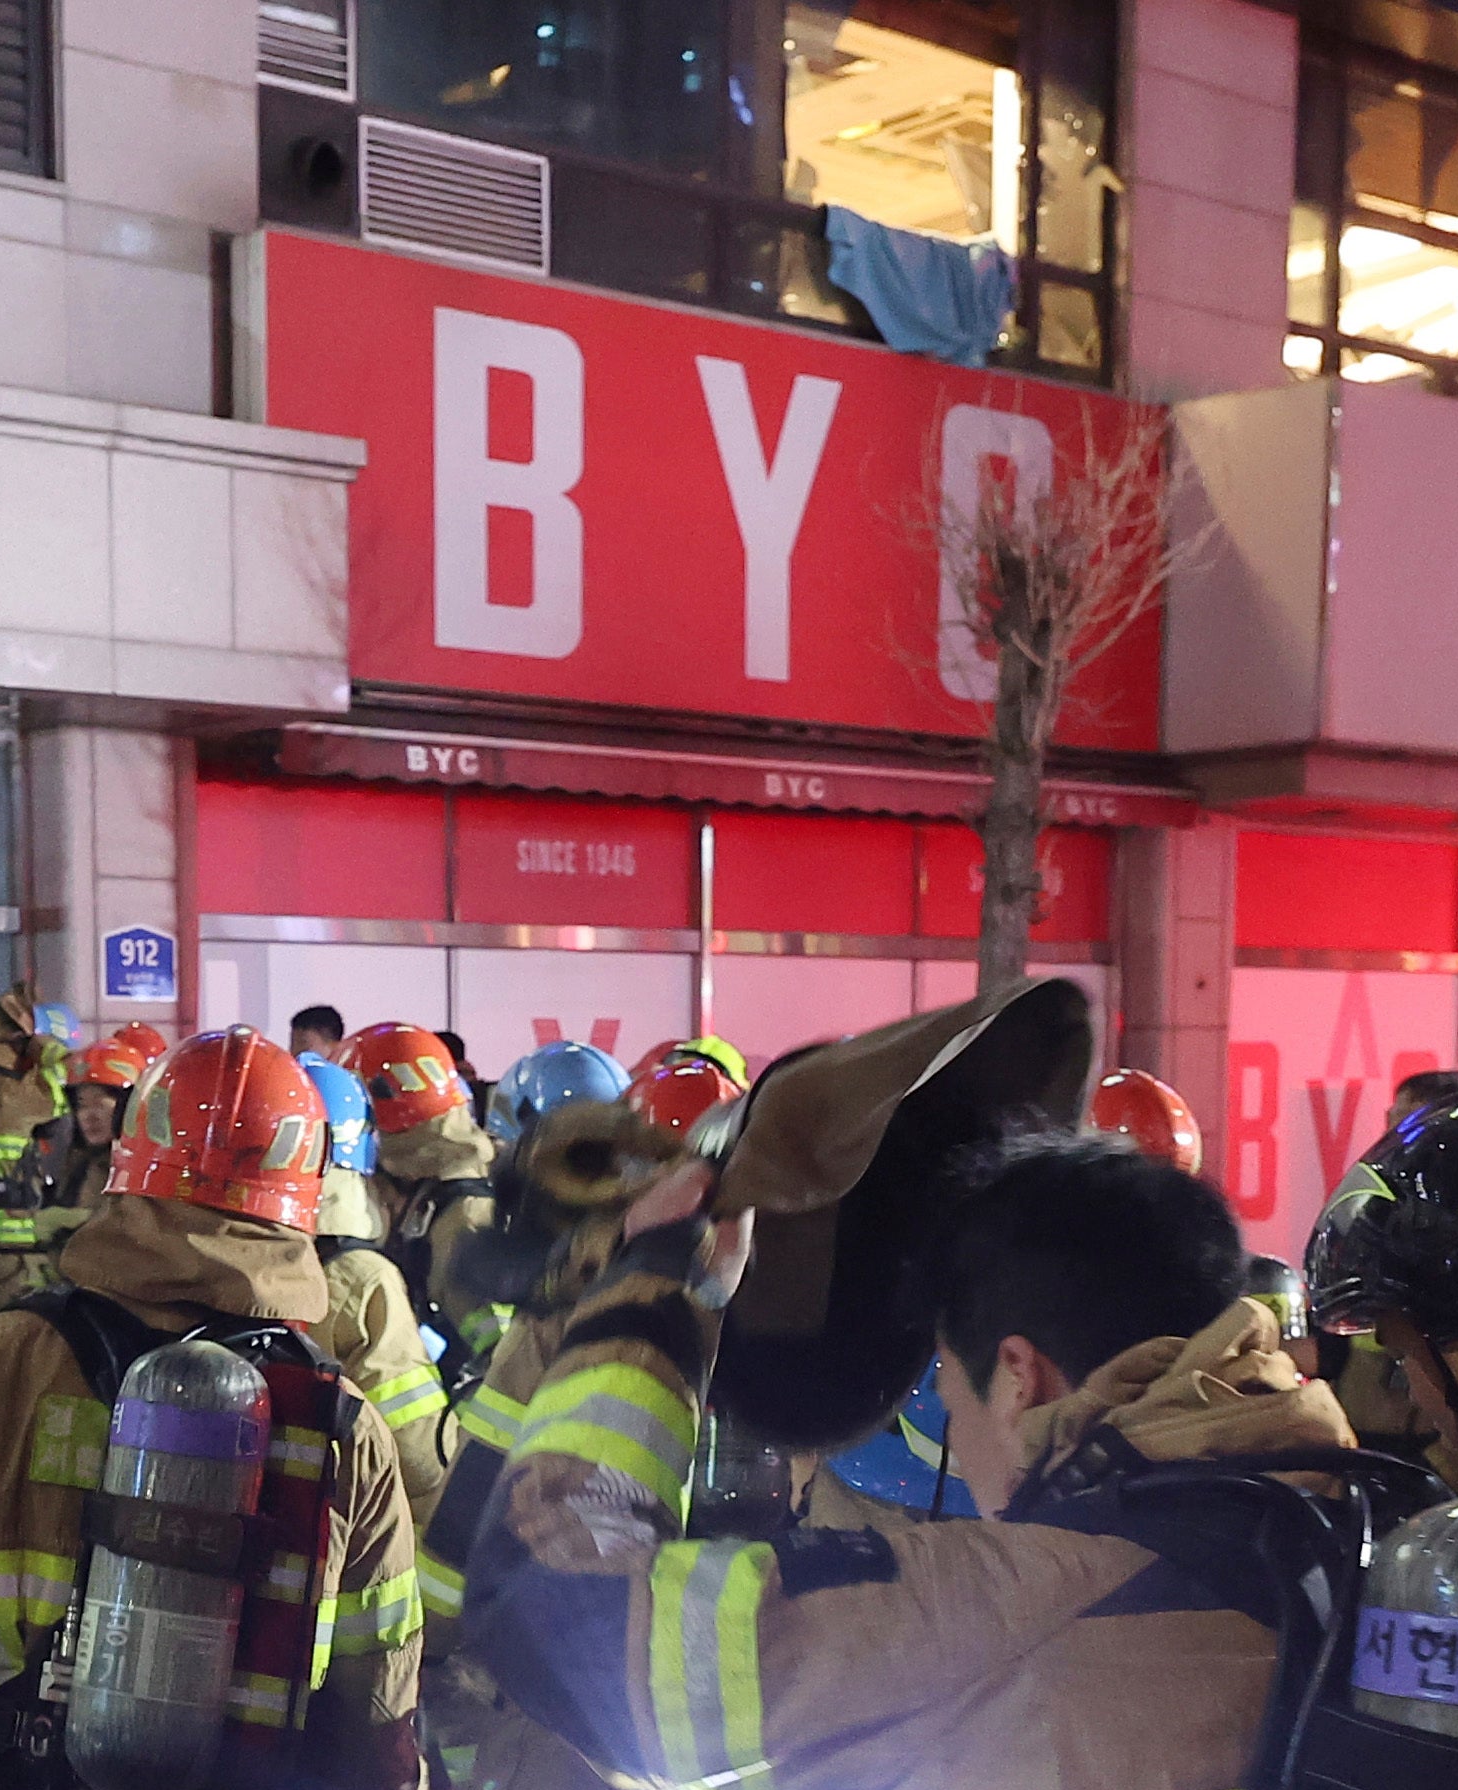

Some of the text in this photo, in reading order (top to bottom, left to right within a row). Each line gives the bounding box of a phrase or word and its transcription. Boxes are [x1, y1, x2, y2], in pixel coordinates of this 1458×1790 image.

[407, 744, 482, 776] BYC
[764, 771, 826, 800] BYC
[516, 838, 577, 877] SINCE
[119, 937, 160, 968] 912
